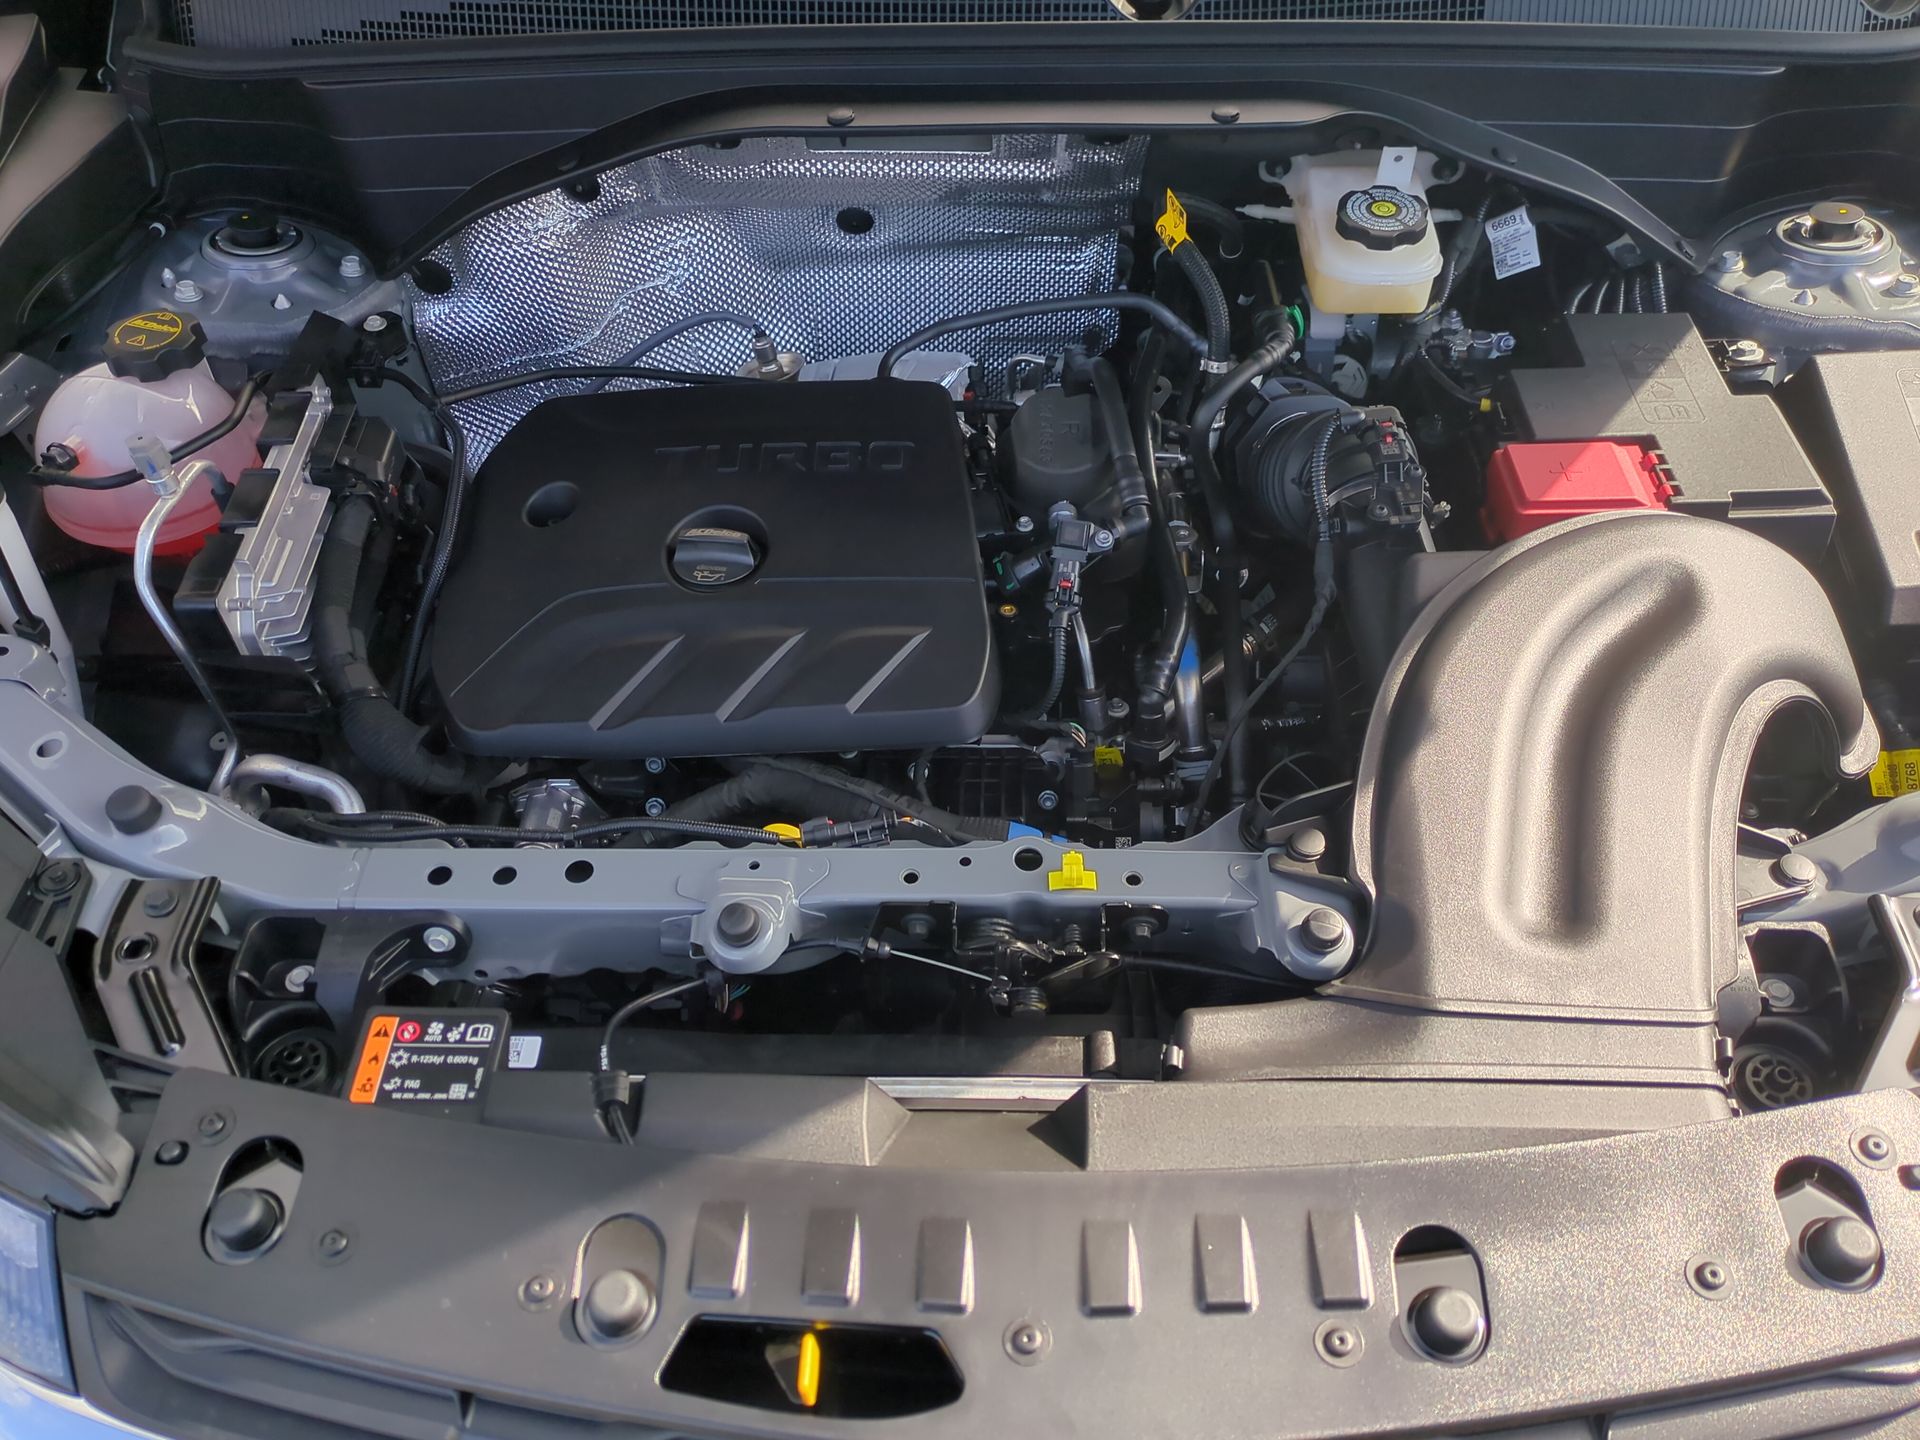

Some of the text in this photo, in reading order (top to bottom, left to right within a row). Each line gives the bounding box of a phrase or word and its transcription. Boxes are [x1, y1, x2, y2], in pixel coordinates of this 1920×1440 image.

[1491, 214, 1517, 231] 6669
[655, 440, 916, 473] TURBO
[1904, 761, 1919, 790] 8768
[424, 1034, 443, 1042] AUTO
[410, 1054, 444, 1065] R-1234yf
[467, 1055, 479, 1065] kg
[403, 1079, 421, 1089] PAG
